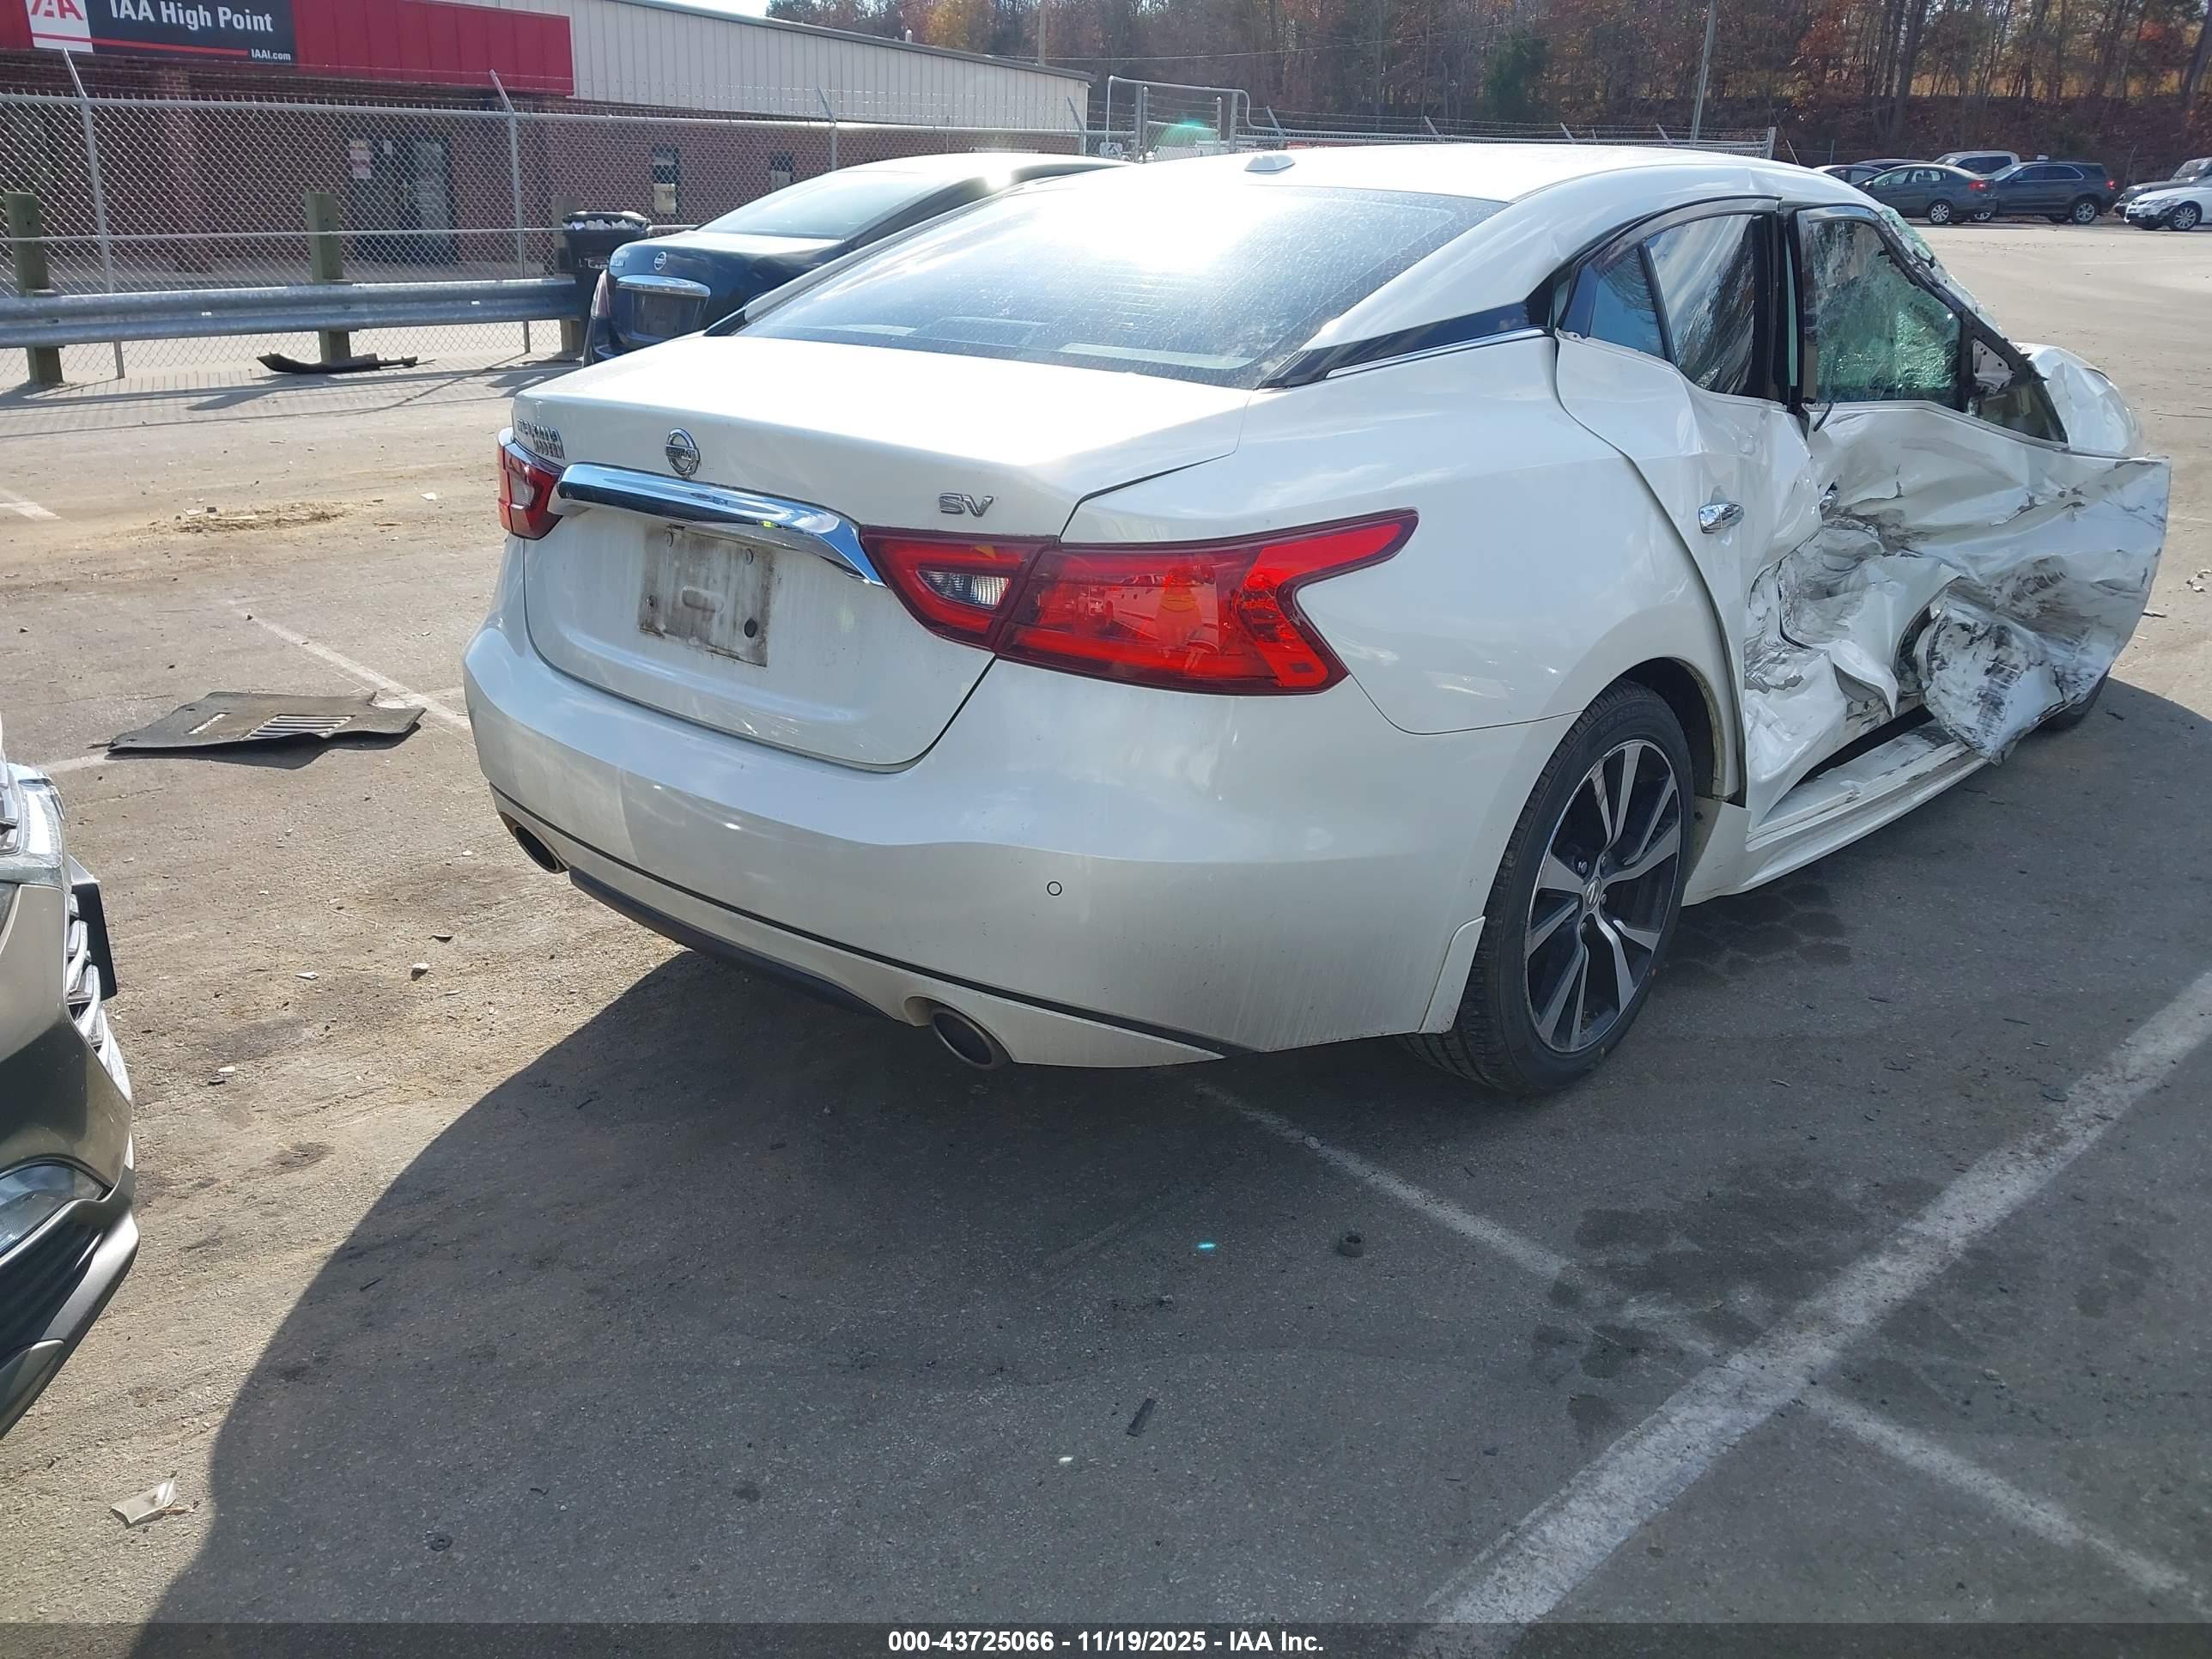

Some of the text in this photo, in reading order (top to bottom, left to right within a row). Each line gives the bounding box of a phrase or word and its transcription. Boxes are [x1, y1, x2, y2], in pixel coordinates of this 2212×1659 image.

[110, 0, 274, 32] IAA High Point
[251, 48, 291, 61] IAAI.com
[939, 492, 994, 517] SV
